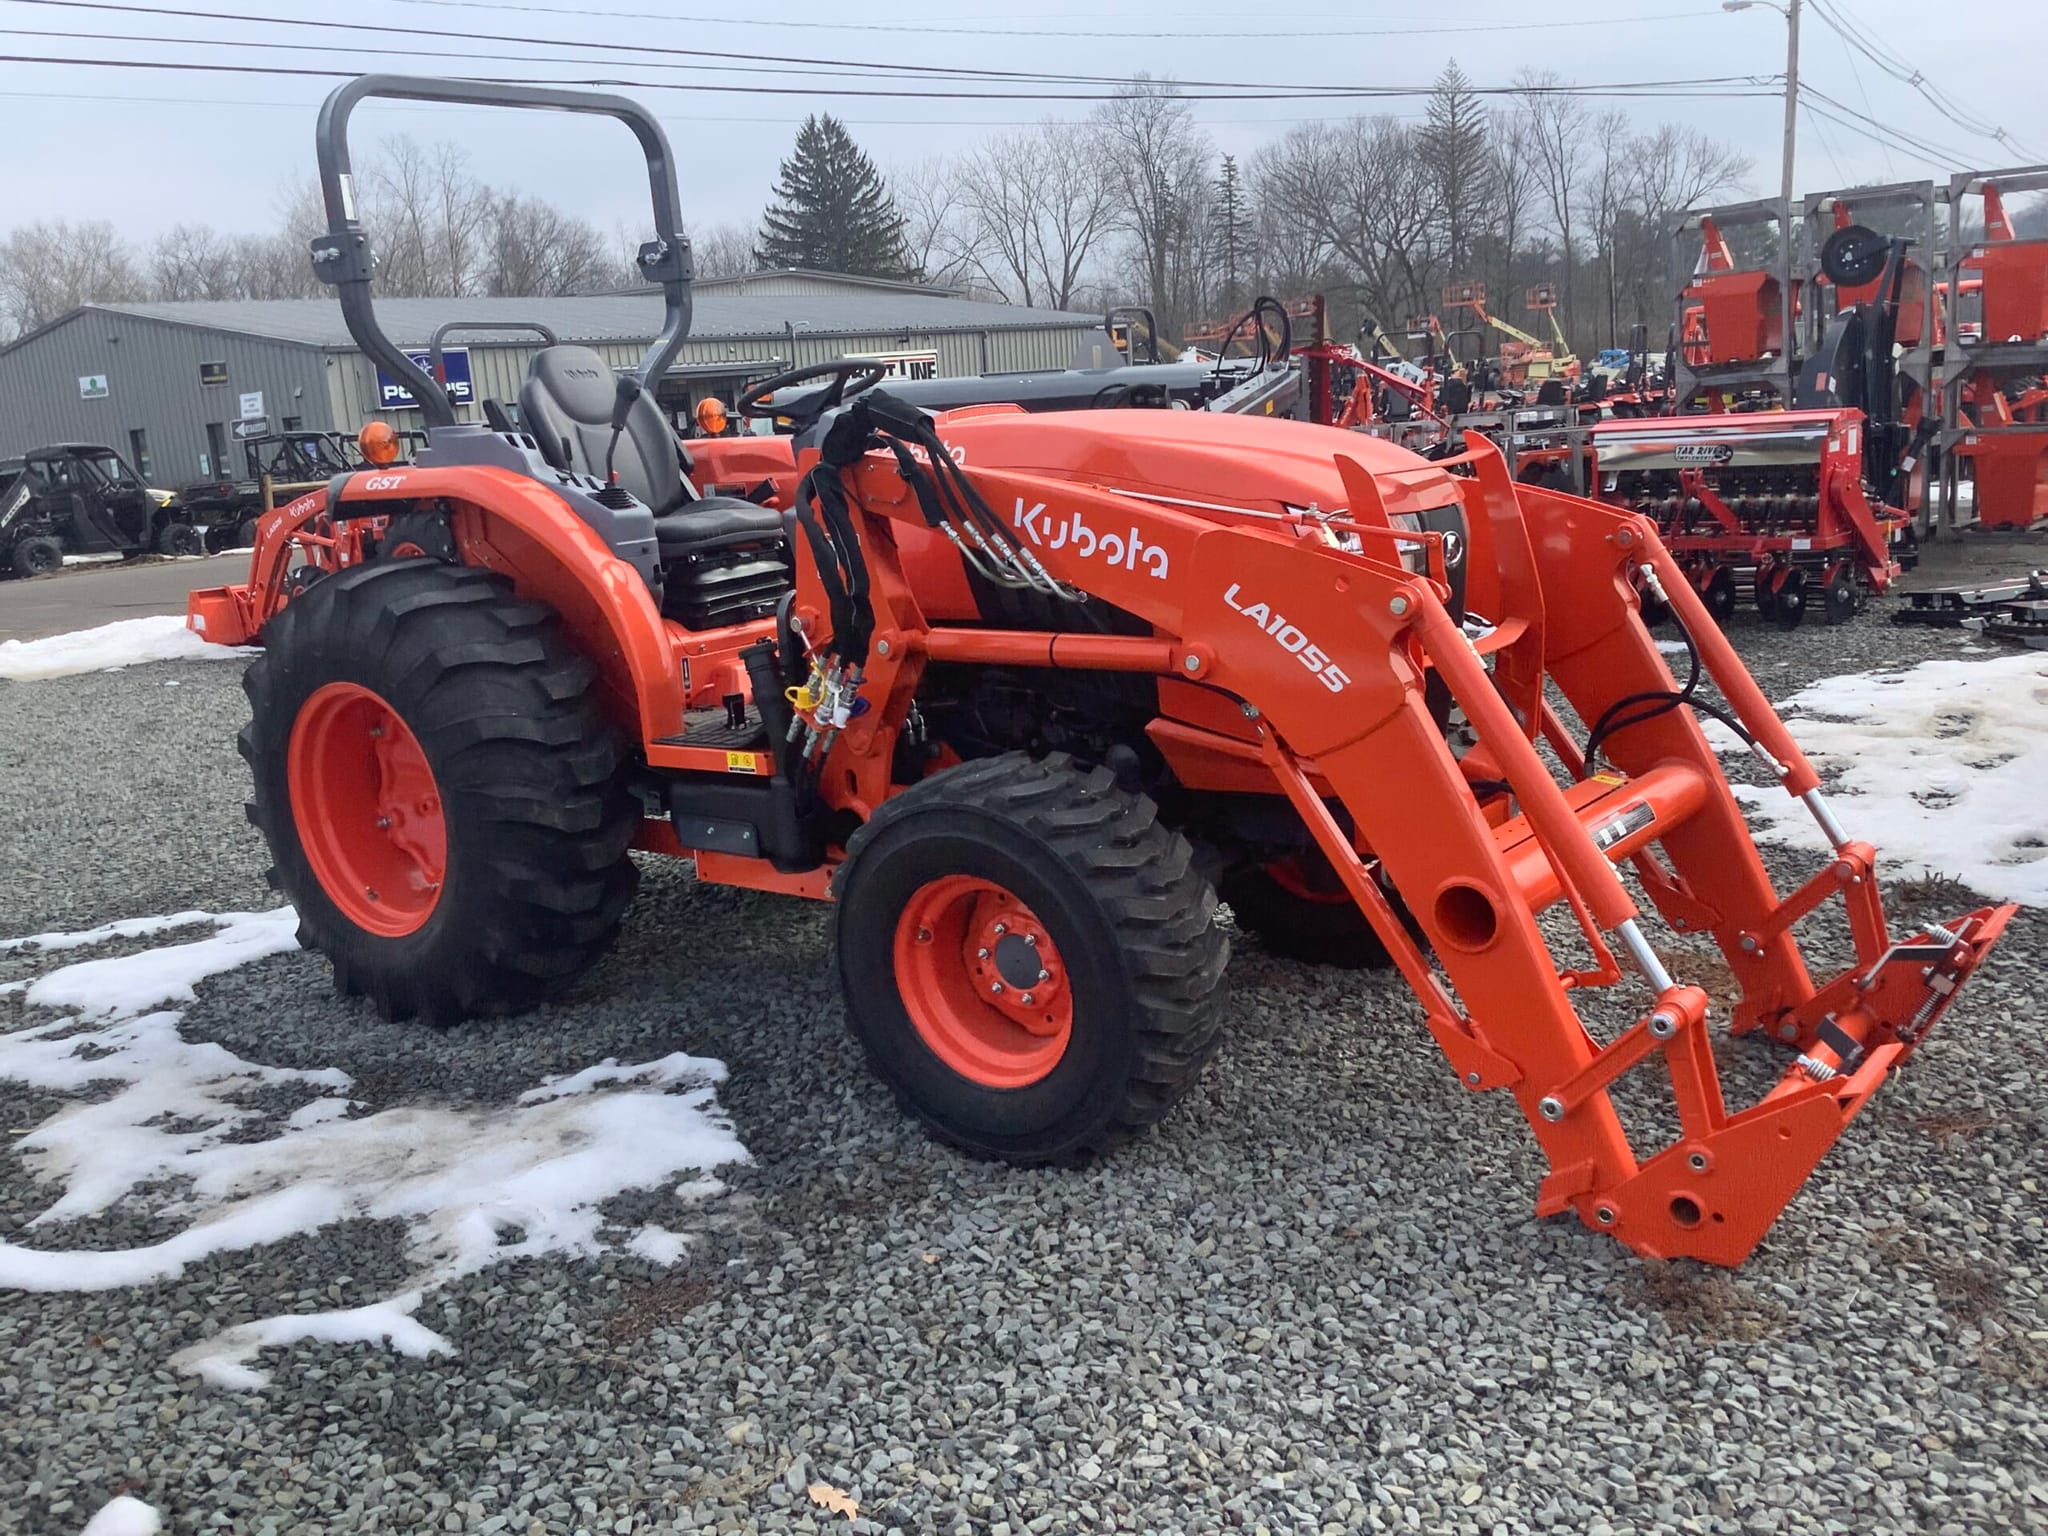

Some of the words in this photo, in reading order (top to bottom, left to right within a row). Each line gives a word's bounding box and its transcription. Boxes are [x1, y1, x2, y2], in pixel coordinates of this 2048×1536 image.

[365, 476, 406, 490] GST
[1013, 497, 1169, 579] Kubota
[1223, 583, 1352, 693] LA1055
